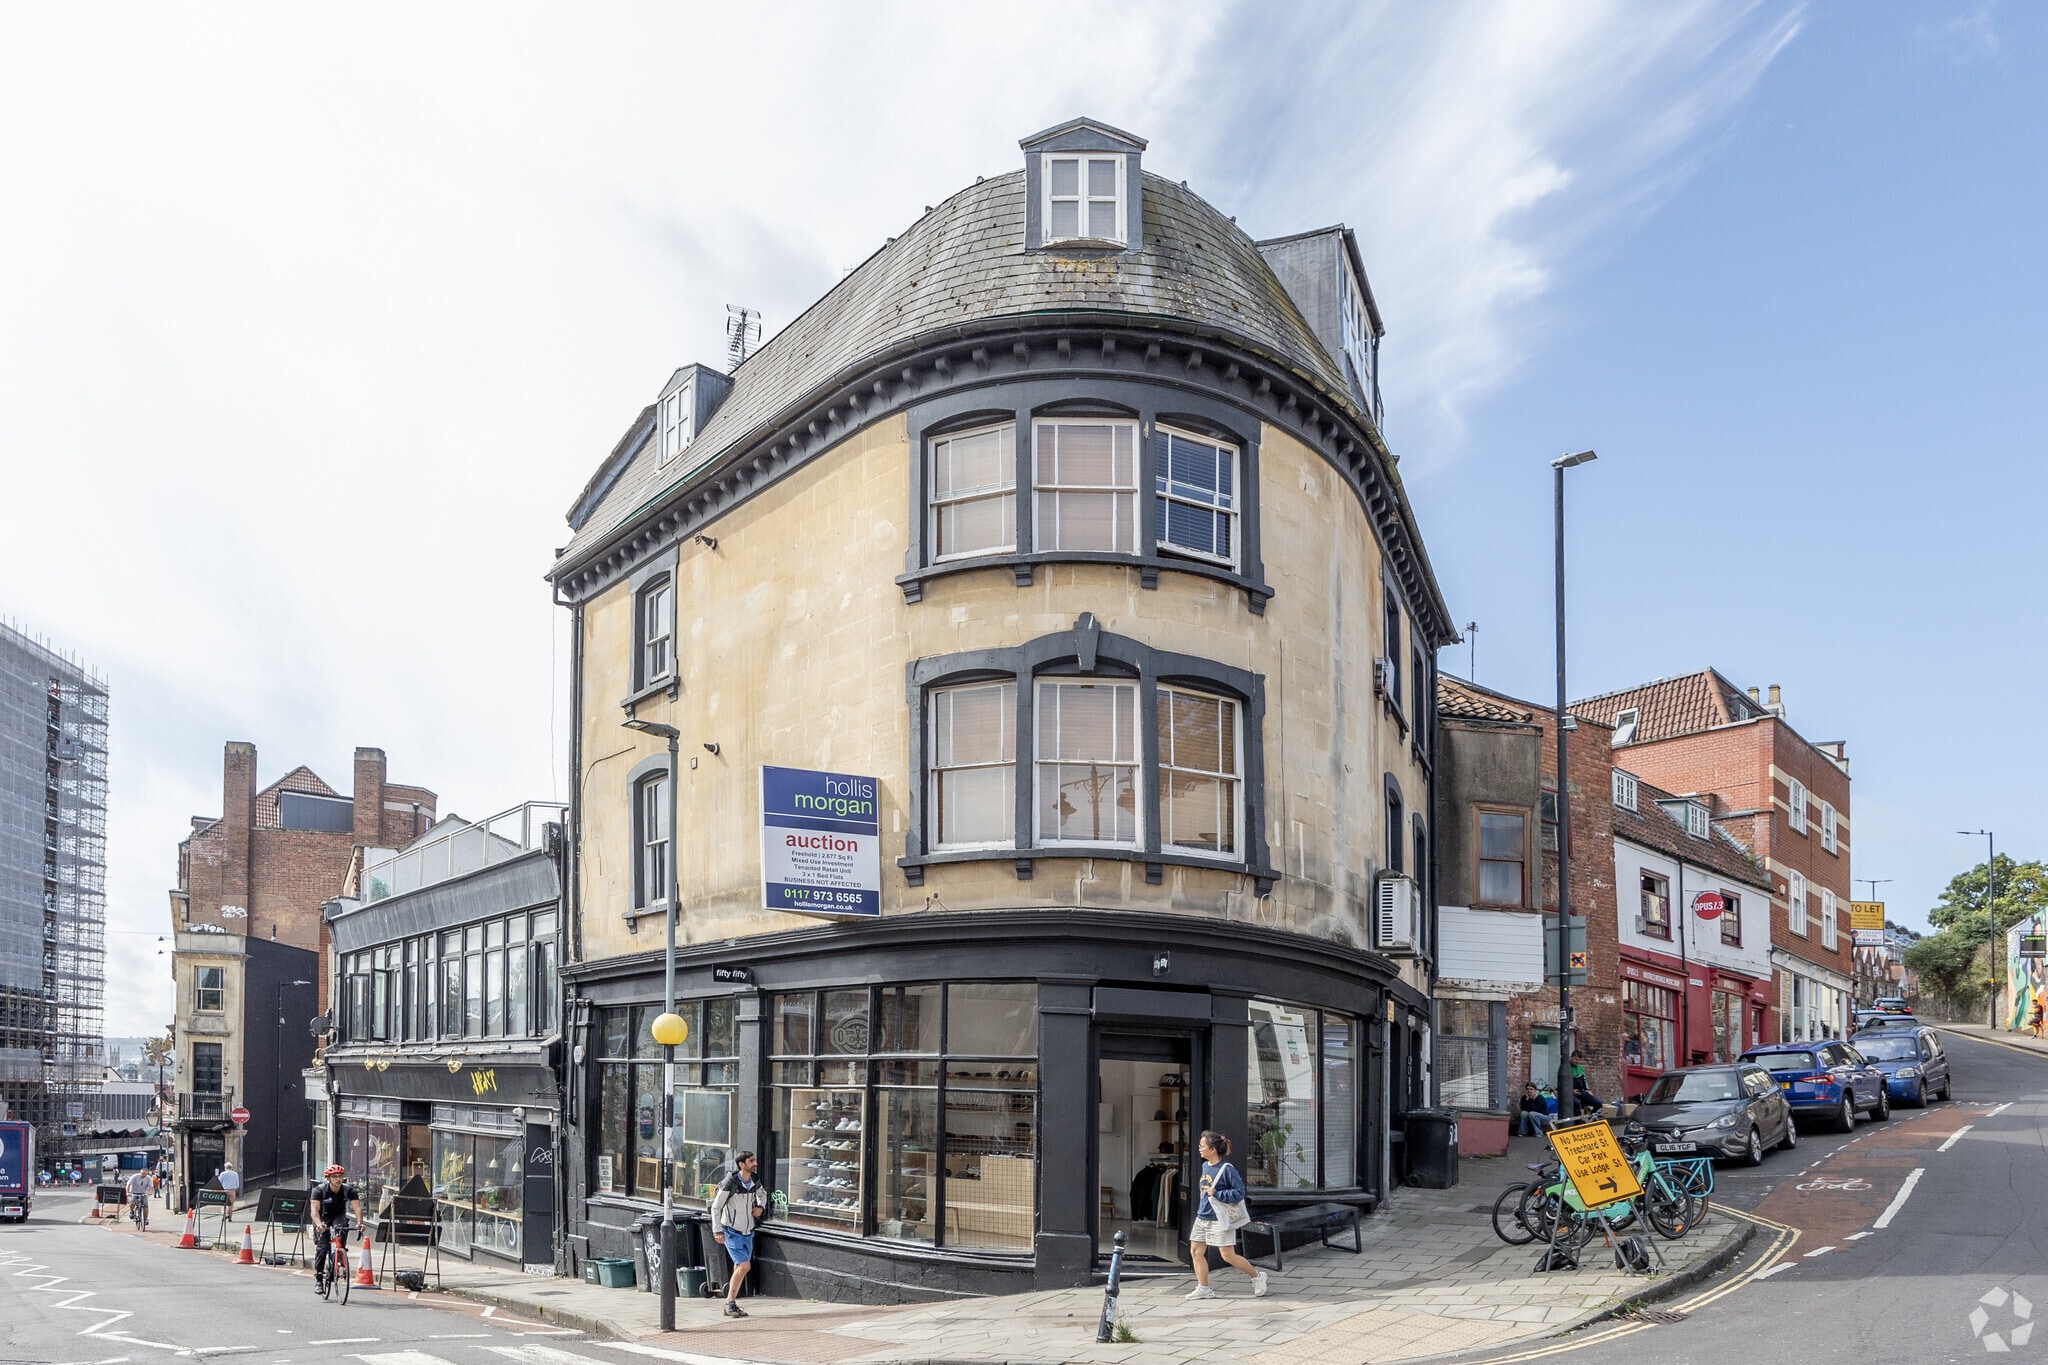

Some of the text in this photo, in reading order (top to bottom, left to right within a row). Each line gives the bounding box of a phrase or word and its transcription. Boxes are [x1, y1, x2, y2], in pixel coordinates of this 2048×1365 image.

[826, 776, 872, 798] hollis
[794, 793, 873, 816] morgan
[786, 834, 858, 852] auction
[791, 850, 817, 858] Freehold
[794, 864, 821, 872] Tenanted
[822, 859, 854, 867] Investment
[784, 876, 815, 885] BUSINESS
[830, 880, 862, 888] AFFECTED
[784, 887, 862, 904] 0117 973 6565
[794, 900, 853, 910] hollismorgan.co.uk
[1850, 904, 1881, 913] TO LET
[716, 969, 747, 980] fifty fifty
[1559, 1129, 1604, 1145] No Access to
[1600, 1138, 1610, 1147] St
[1577, 1151, 1608, 1165] Car Park
[1574, 1158, 1623, 1178] Use Lodge St
[202, 1192, 226, 1201] CORE
